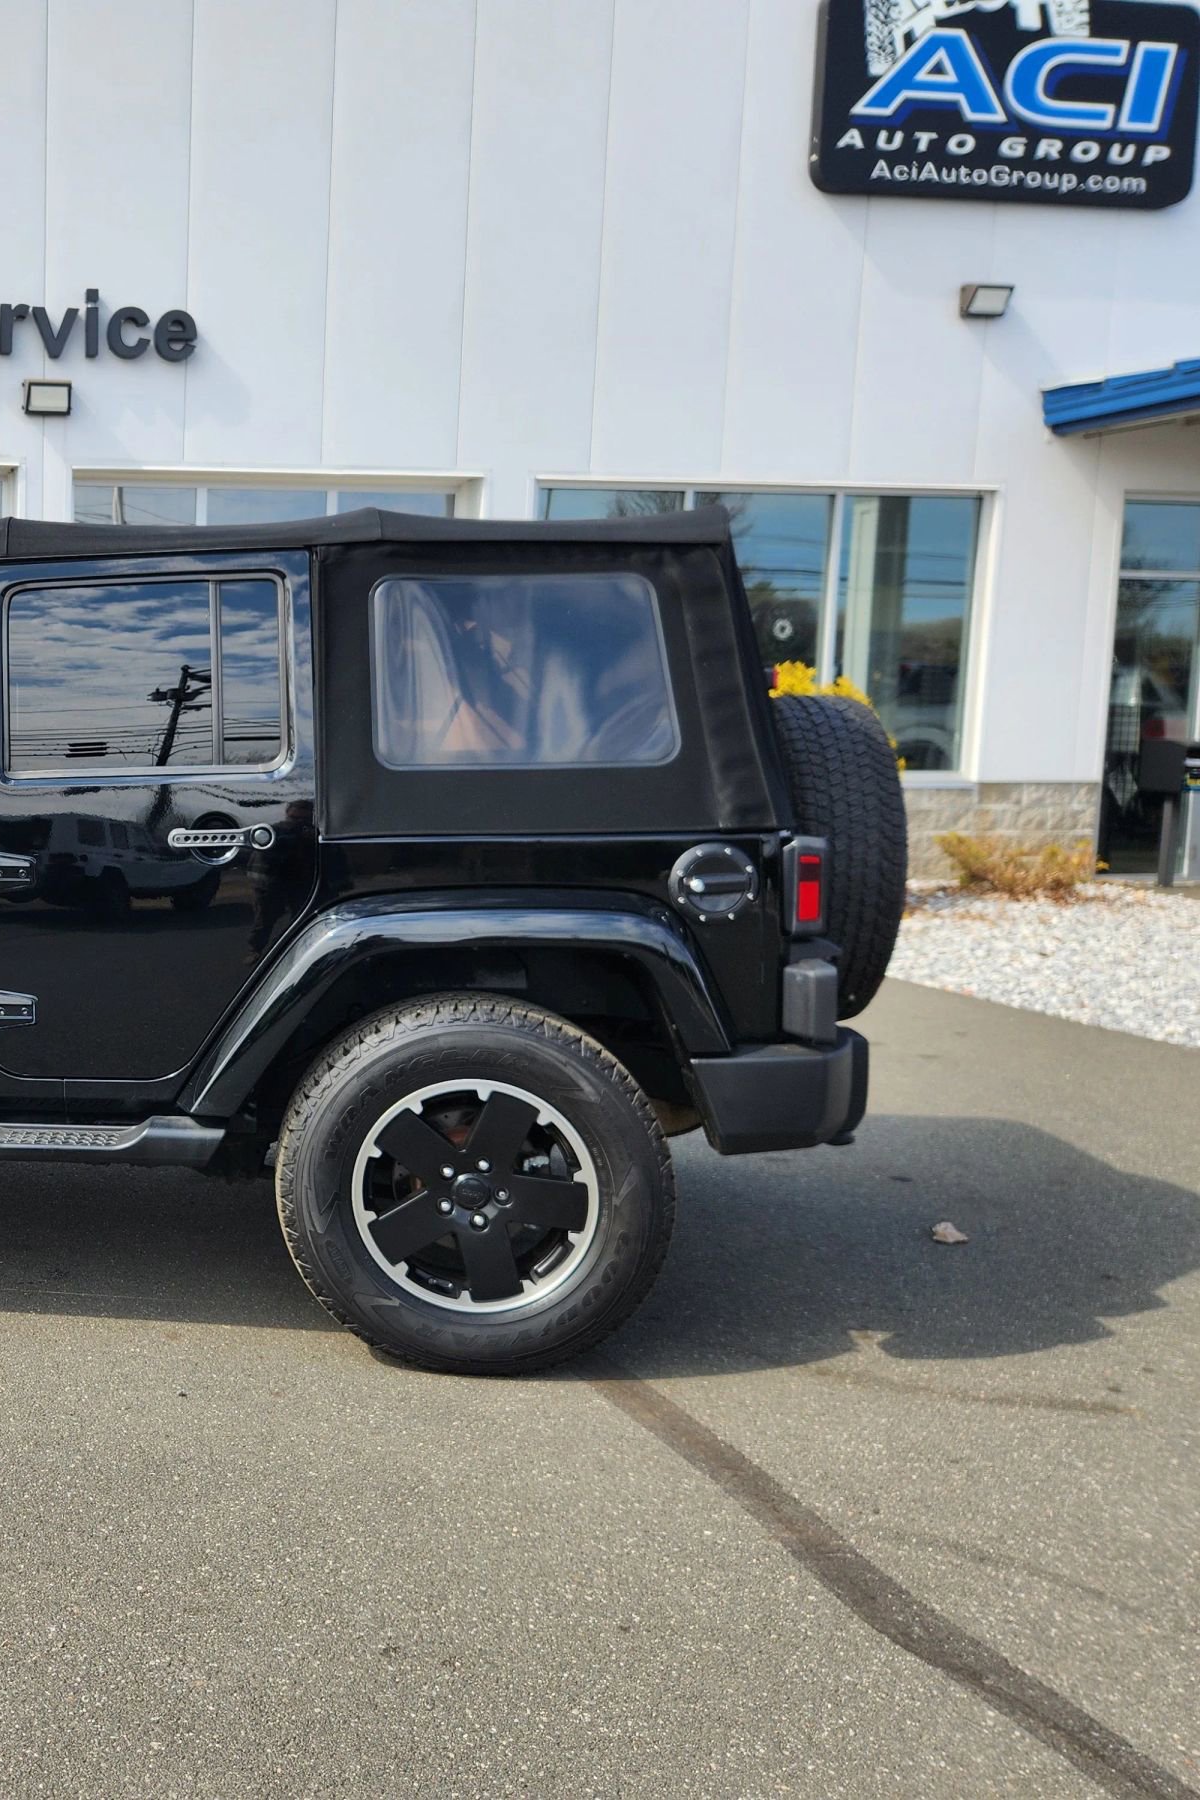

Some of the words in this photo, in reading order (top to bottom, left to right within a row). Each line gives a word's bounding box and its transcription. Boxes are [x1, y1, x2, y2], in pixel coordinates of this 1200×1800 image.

[849, 27, 1182, 135] ACI
[834, 128, 977, 156] AUTO
[997, 137, 1172, 167] GROUP
[869, 159, 1147, 194] AciAutoGroup.com
